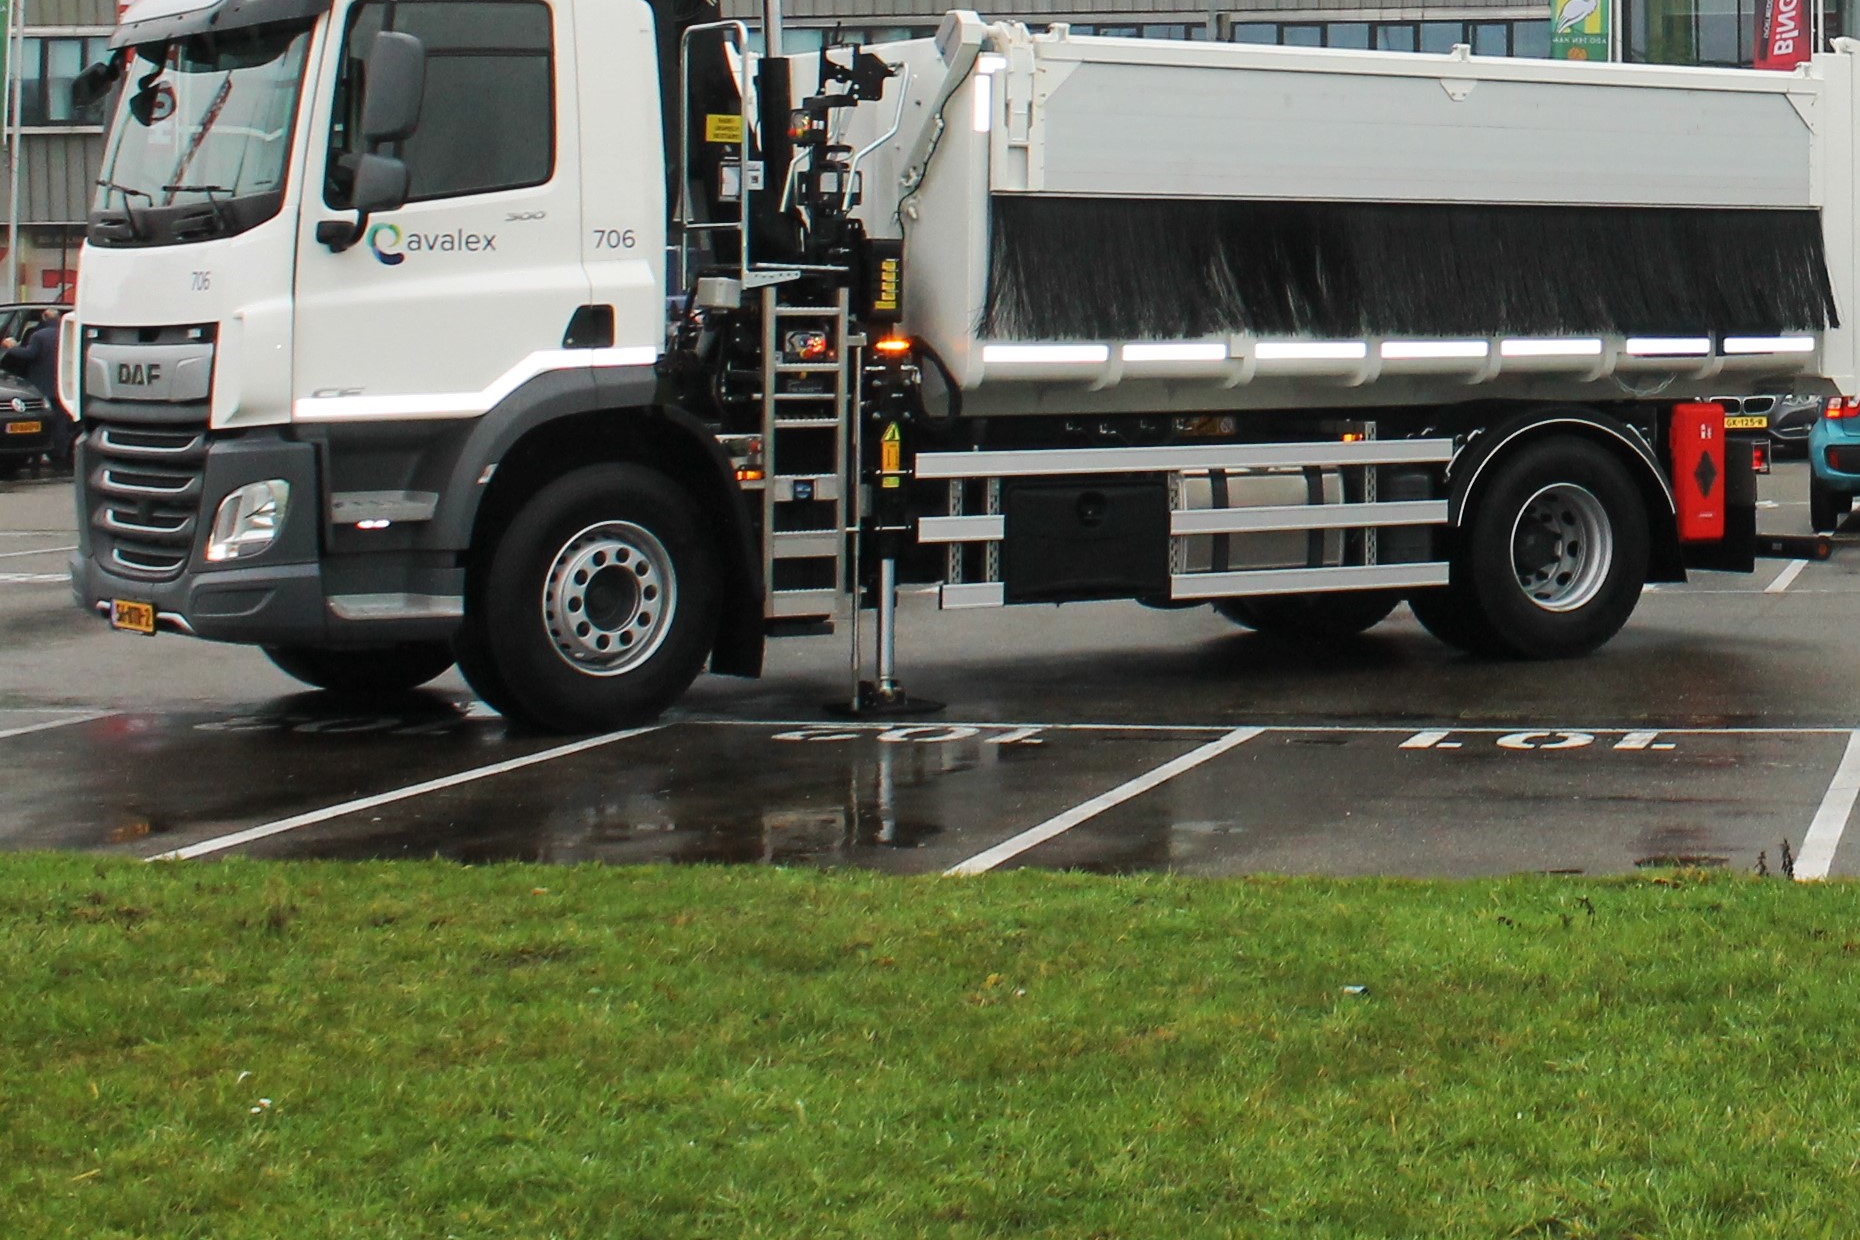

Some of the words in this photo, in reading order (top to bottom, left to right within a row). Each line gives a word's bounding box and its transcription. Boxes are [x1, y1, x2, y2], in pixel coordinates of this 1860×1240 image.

[407, 228, 497, 252] avalex
[593, 229, 636, 249] 706
[191, 271, 211, 291] 706
[118, 363, 162, 386] DAF
